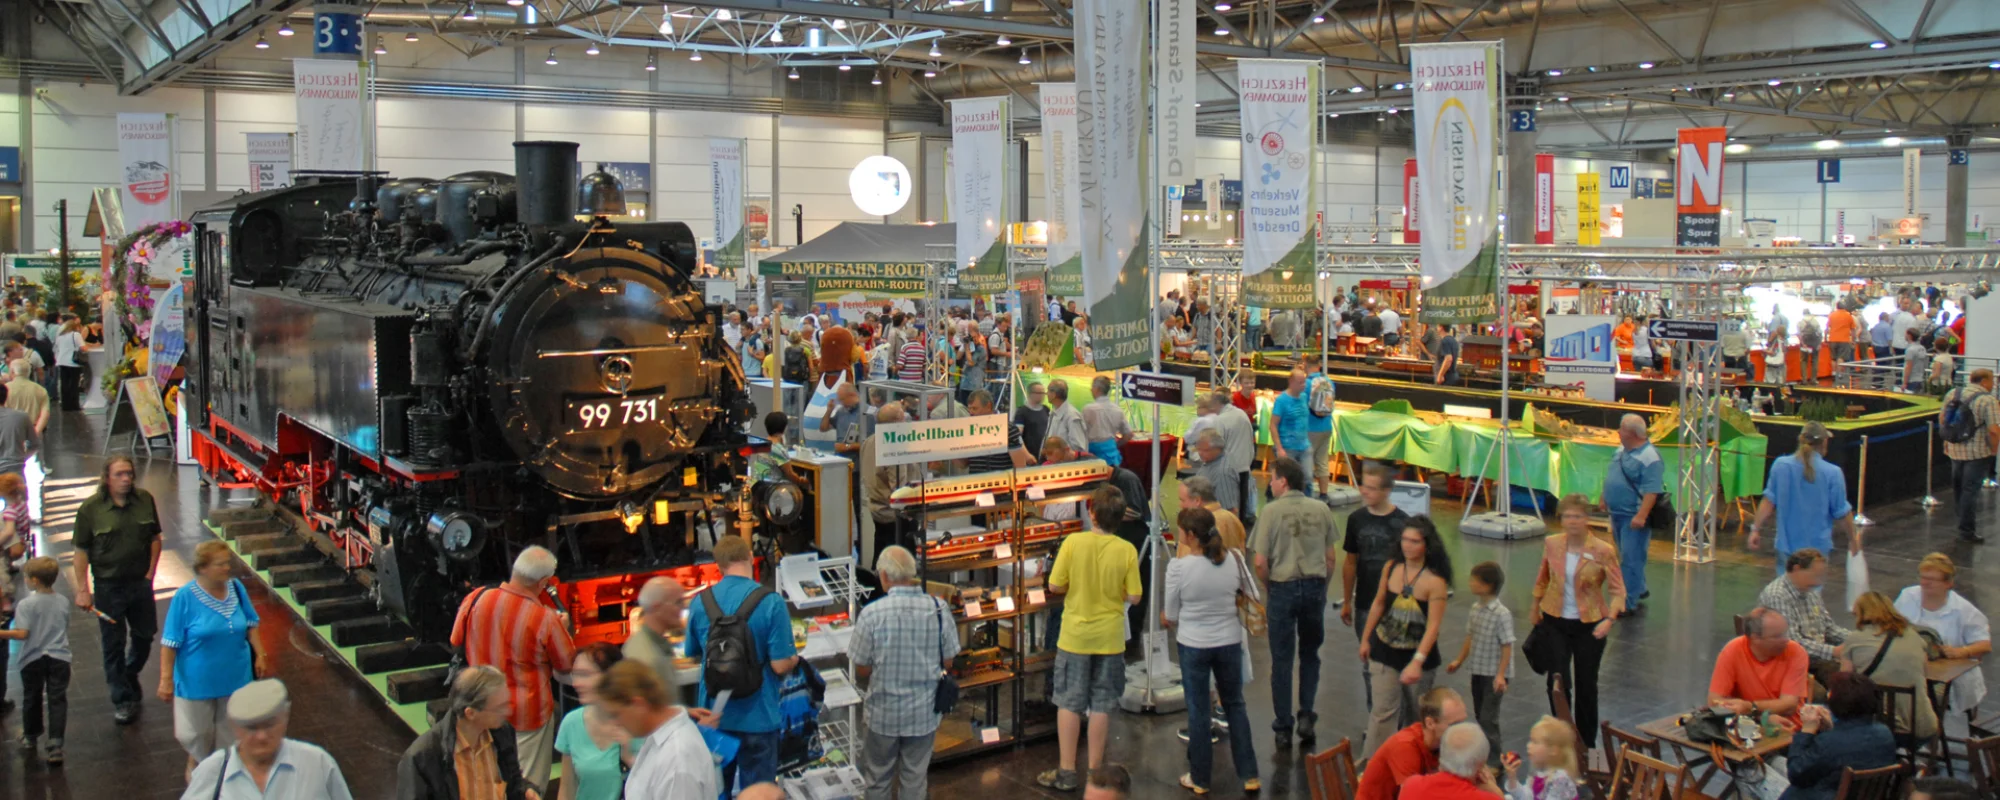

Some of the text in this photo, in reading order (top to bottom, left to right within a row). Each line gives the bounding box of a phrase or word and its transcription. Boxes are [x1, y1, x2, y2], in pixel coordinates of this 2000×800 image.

[318, 16, 334, 48] 3
[1520, 111, 1530, 130] 3
[1958, 150, 1967, 164] 3
[1612, 168, 1628, 186] M
[1680, 142, 1724, 206] N
[1823, 162, 1834, 180] L
[1684, 216, 1714, 226] Spoor
[1688, 229, 1712, 239] Spur
[818, 280, 926, 290] DAMPFBAHN-ROUTE
[1667, 322, 1716, 330] DAMPFBAHN-ROUTE
[1550, 323, 1611, 362] ZIMO
[1137, 378, 1180, 390] DAMPFBAHN-ROUTE
[1137, 388, 1156, 398] Sachsen
[580, 398, 656, 428] 99 731
[883, 423, 1002, 444] Modellbau Frey
